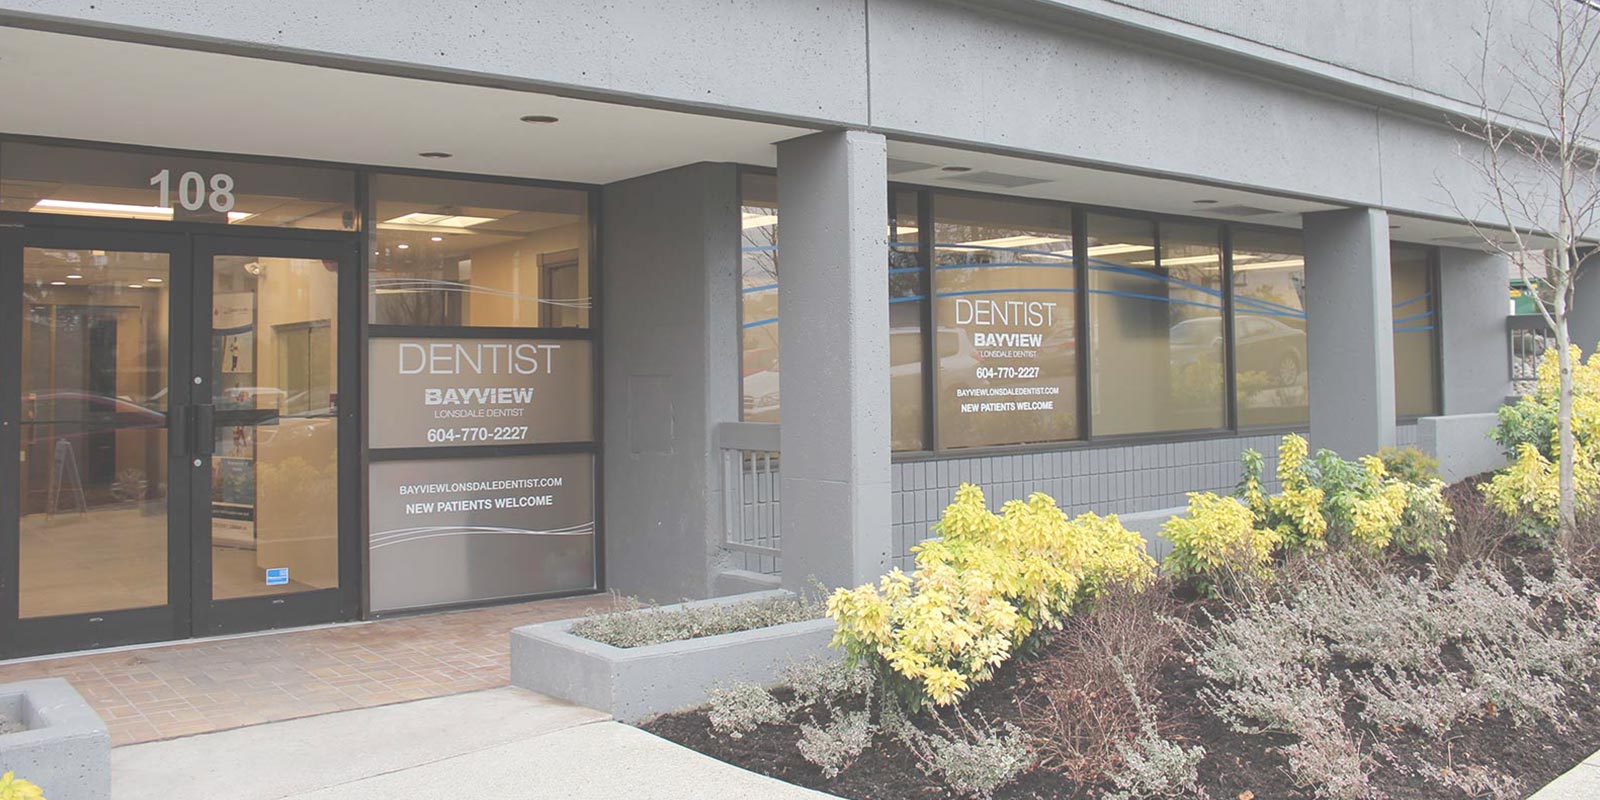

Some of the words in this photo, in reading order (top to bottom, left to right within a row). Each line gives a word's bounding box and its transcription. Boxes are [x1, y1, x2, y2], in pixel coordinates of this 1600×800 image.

[150, 169, 235, 213] 108
[955, 298, 1057, 327] DENTIST
[974, 333, 1043, 347] BAYVIEW
[399, 343, 561, 374] DENTIST
[980, 350, 1012, 358] LONSDALE
[976, 367, 1040, 378] 604-770-2227
[425, 388, 534, 405] BAYVIEW
[957, 387, 1059, 397] BAYVIEWLONSDALEDENTIST.COM
[434, 409, 485, 419] LONSDALE
[486, 408, 525, 418] DENTIST
[961, 403, 979, 413] NEW
[980, 402, 1016, 412] PATIENTS
[1016, 401, 1054, 411] WELCOME
[427, 426, 529, 442] 604-770-2227
[399, 477, 563, 495] BAYVIEWLONSDALEDENTIST.COM
[406, 503, 435, 514] NEW
[437, 499, 492, 513] PATIENTS
[494, 495, 553, 509] WELCOME
